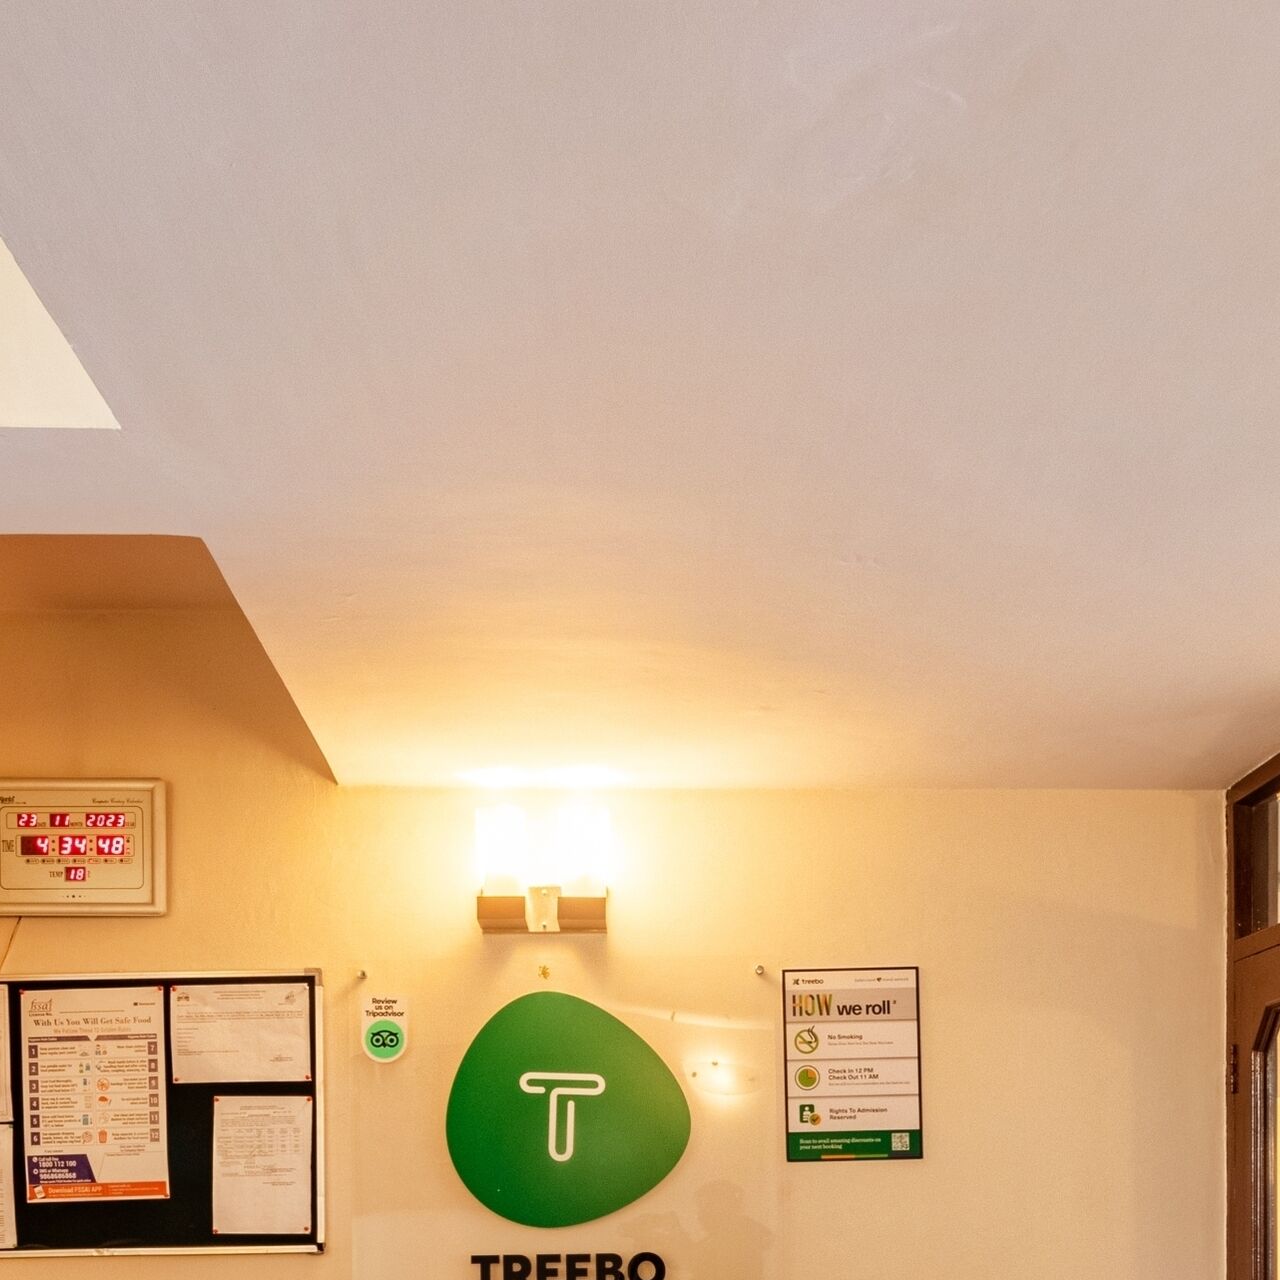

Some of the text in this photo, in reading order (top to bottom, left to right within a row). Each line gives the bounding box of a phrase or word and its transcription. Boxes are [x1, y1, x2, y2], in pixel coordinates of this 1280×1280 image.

[18, 813, 38, 827] 23
[54, 814, 70, 827] 11
[86, 813, 125, 827] 2023
[69, 868, 85, 881] 18
[802, 978, 824, 986] treebo
[372, 997, 398, 1005] Review
[792, 993, 891, 1017] HOW we roll
[365, 1010, 405, 1018] Tripadvisor
[33, 1014, 152, 1027] With Us You Will Get Safe Food
[838, 1033, 863, 1041] Smoking
[857, 1106, 888, 1114] Admission
[39, 1160, 53, 1168] 1800
[54, 1160, 64, 1168] 112
